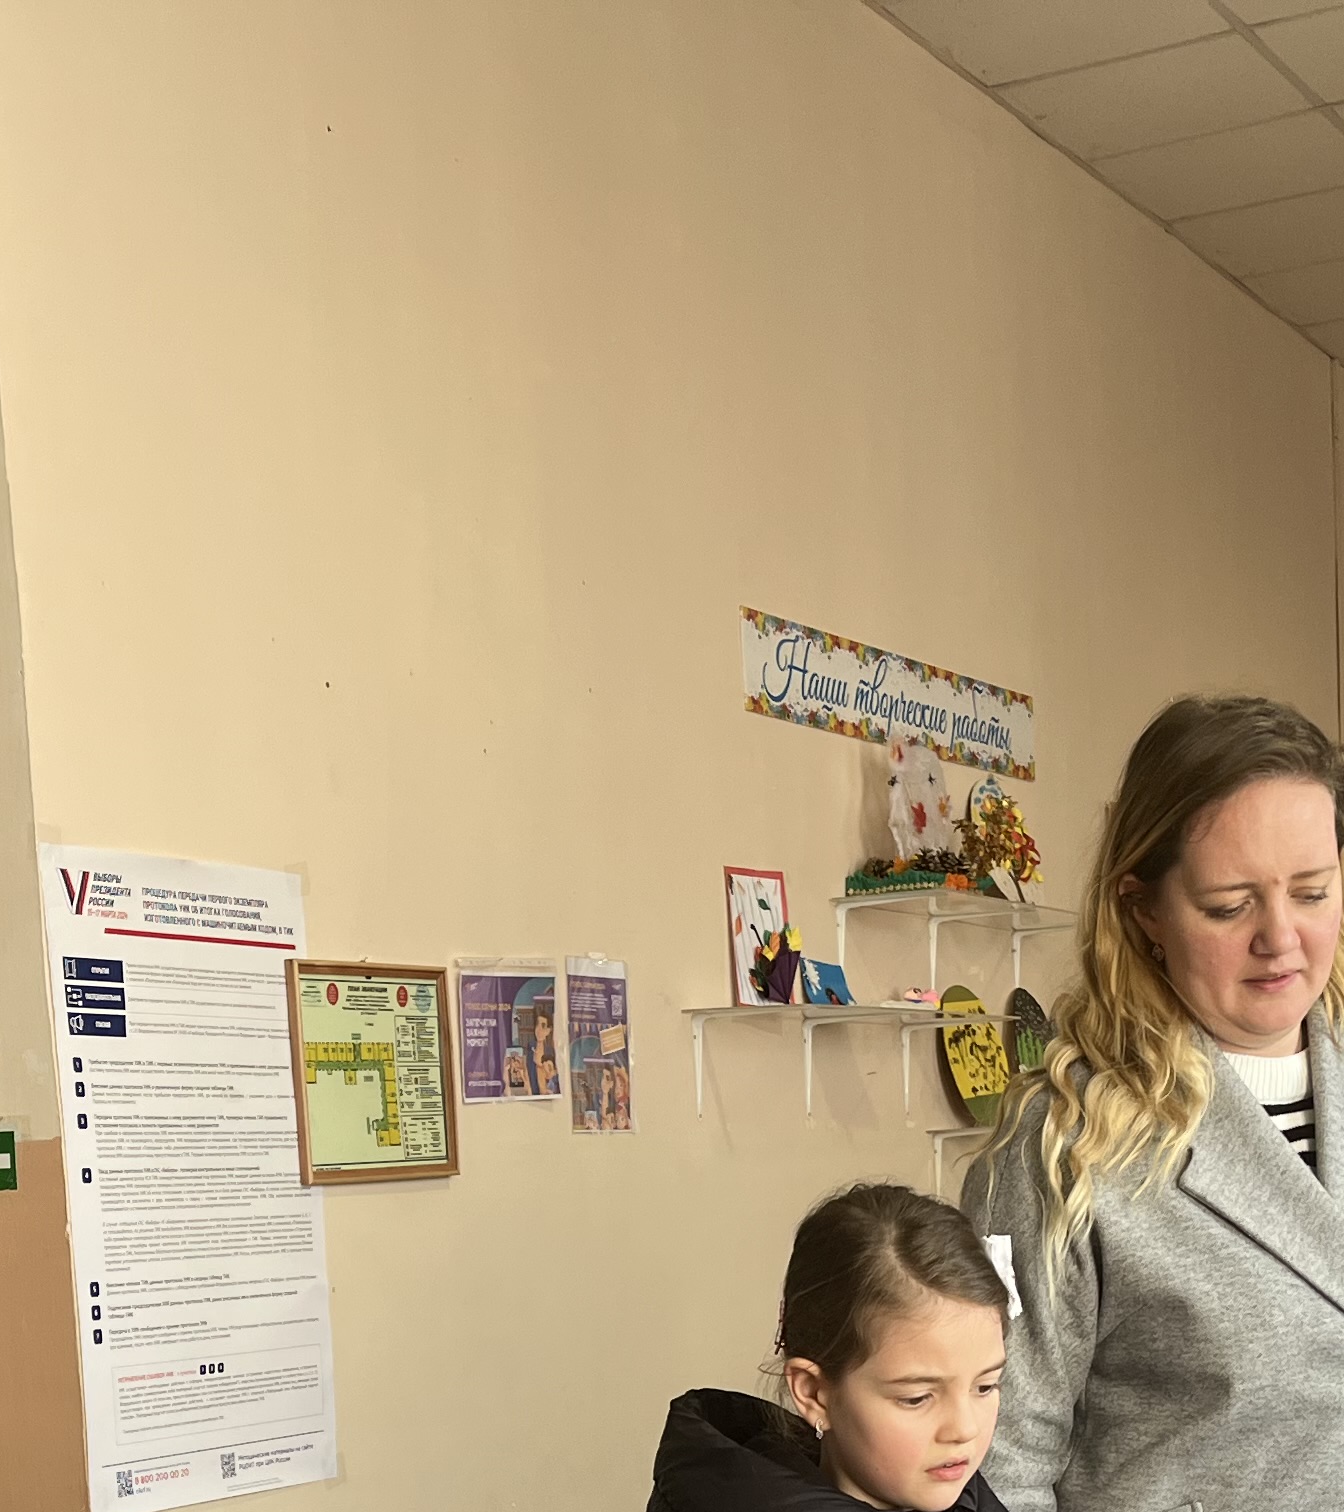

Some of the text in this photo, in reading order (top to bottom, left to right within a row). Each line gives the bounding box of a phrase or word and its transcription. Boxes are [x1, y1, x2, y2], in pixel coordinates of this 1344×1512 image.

[762, 635, 1011, 755] Наши творческие работы
[93, 872, 122, 883] ВЫБОРЫ
[90, 884, 132, 897] ПРЕЗИДЕНТА
[142, 887, 176, 899] ПРОЦЕДУРА
[178, 891, 206, 902] ПЕРЕДАЧИ
[88, 897, 114, 907] РОССИИ
